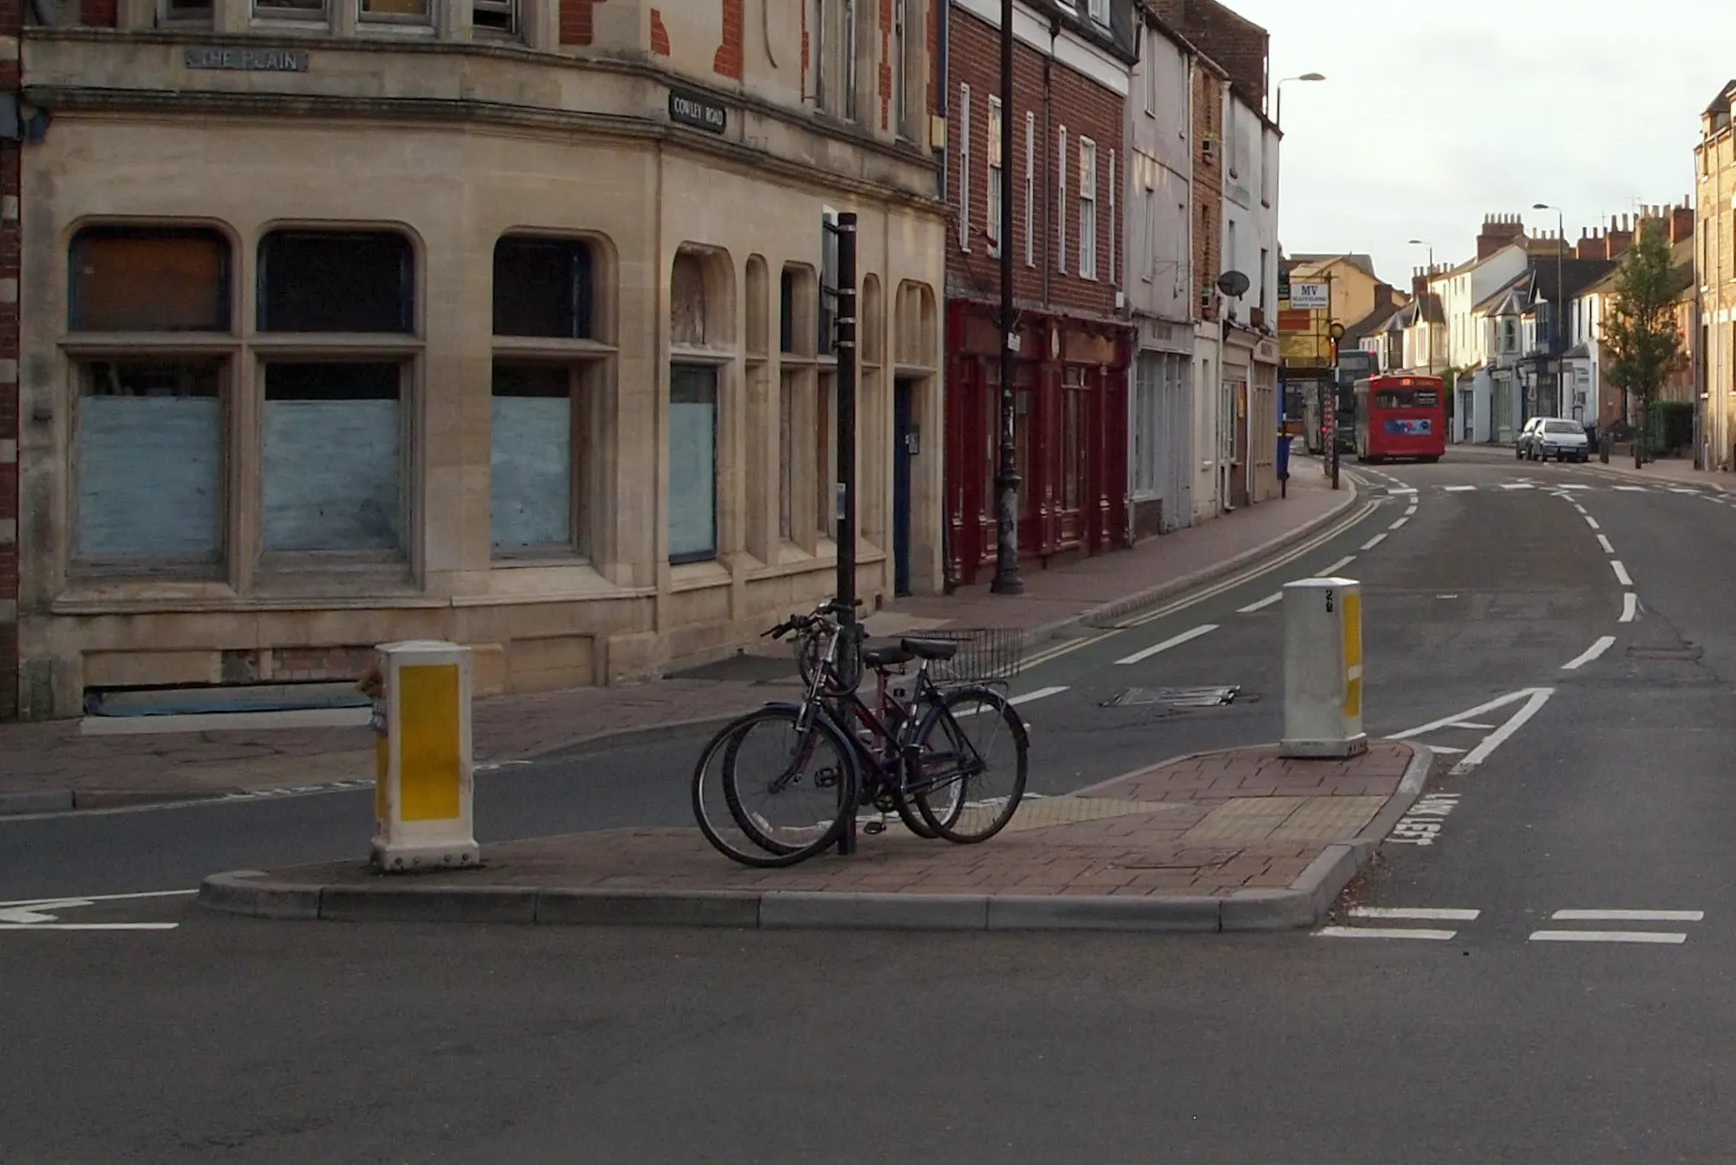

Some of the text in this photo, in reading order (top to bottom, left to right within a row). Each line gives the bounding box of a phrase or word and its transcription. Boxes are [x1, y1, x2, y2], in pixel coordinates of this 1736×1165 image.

[201, 49, 297, 70] THE PLAIN
[674, 97, 723, 125] COWLEY ROAD
